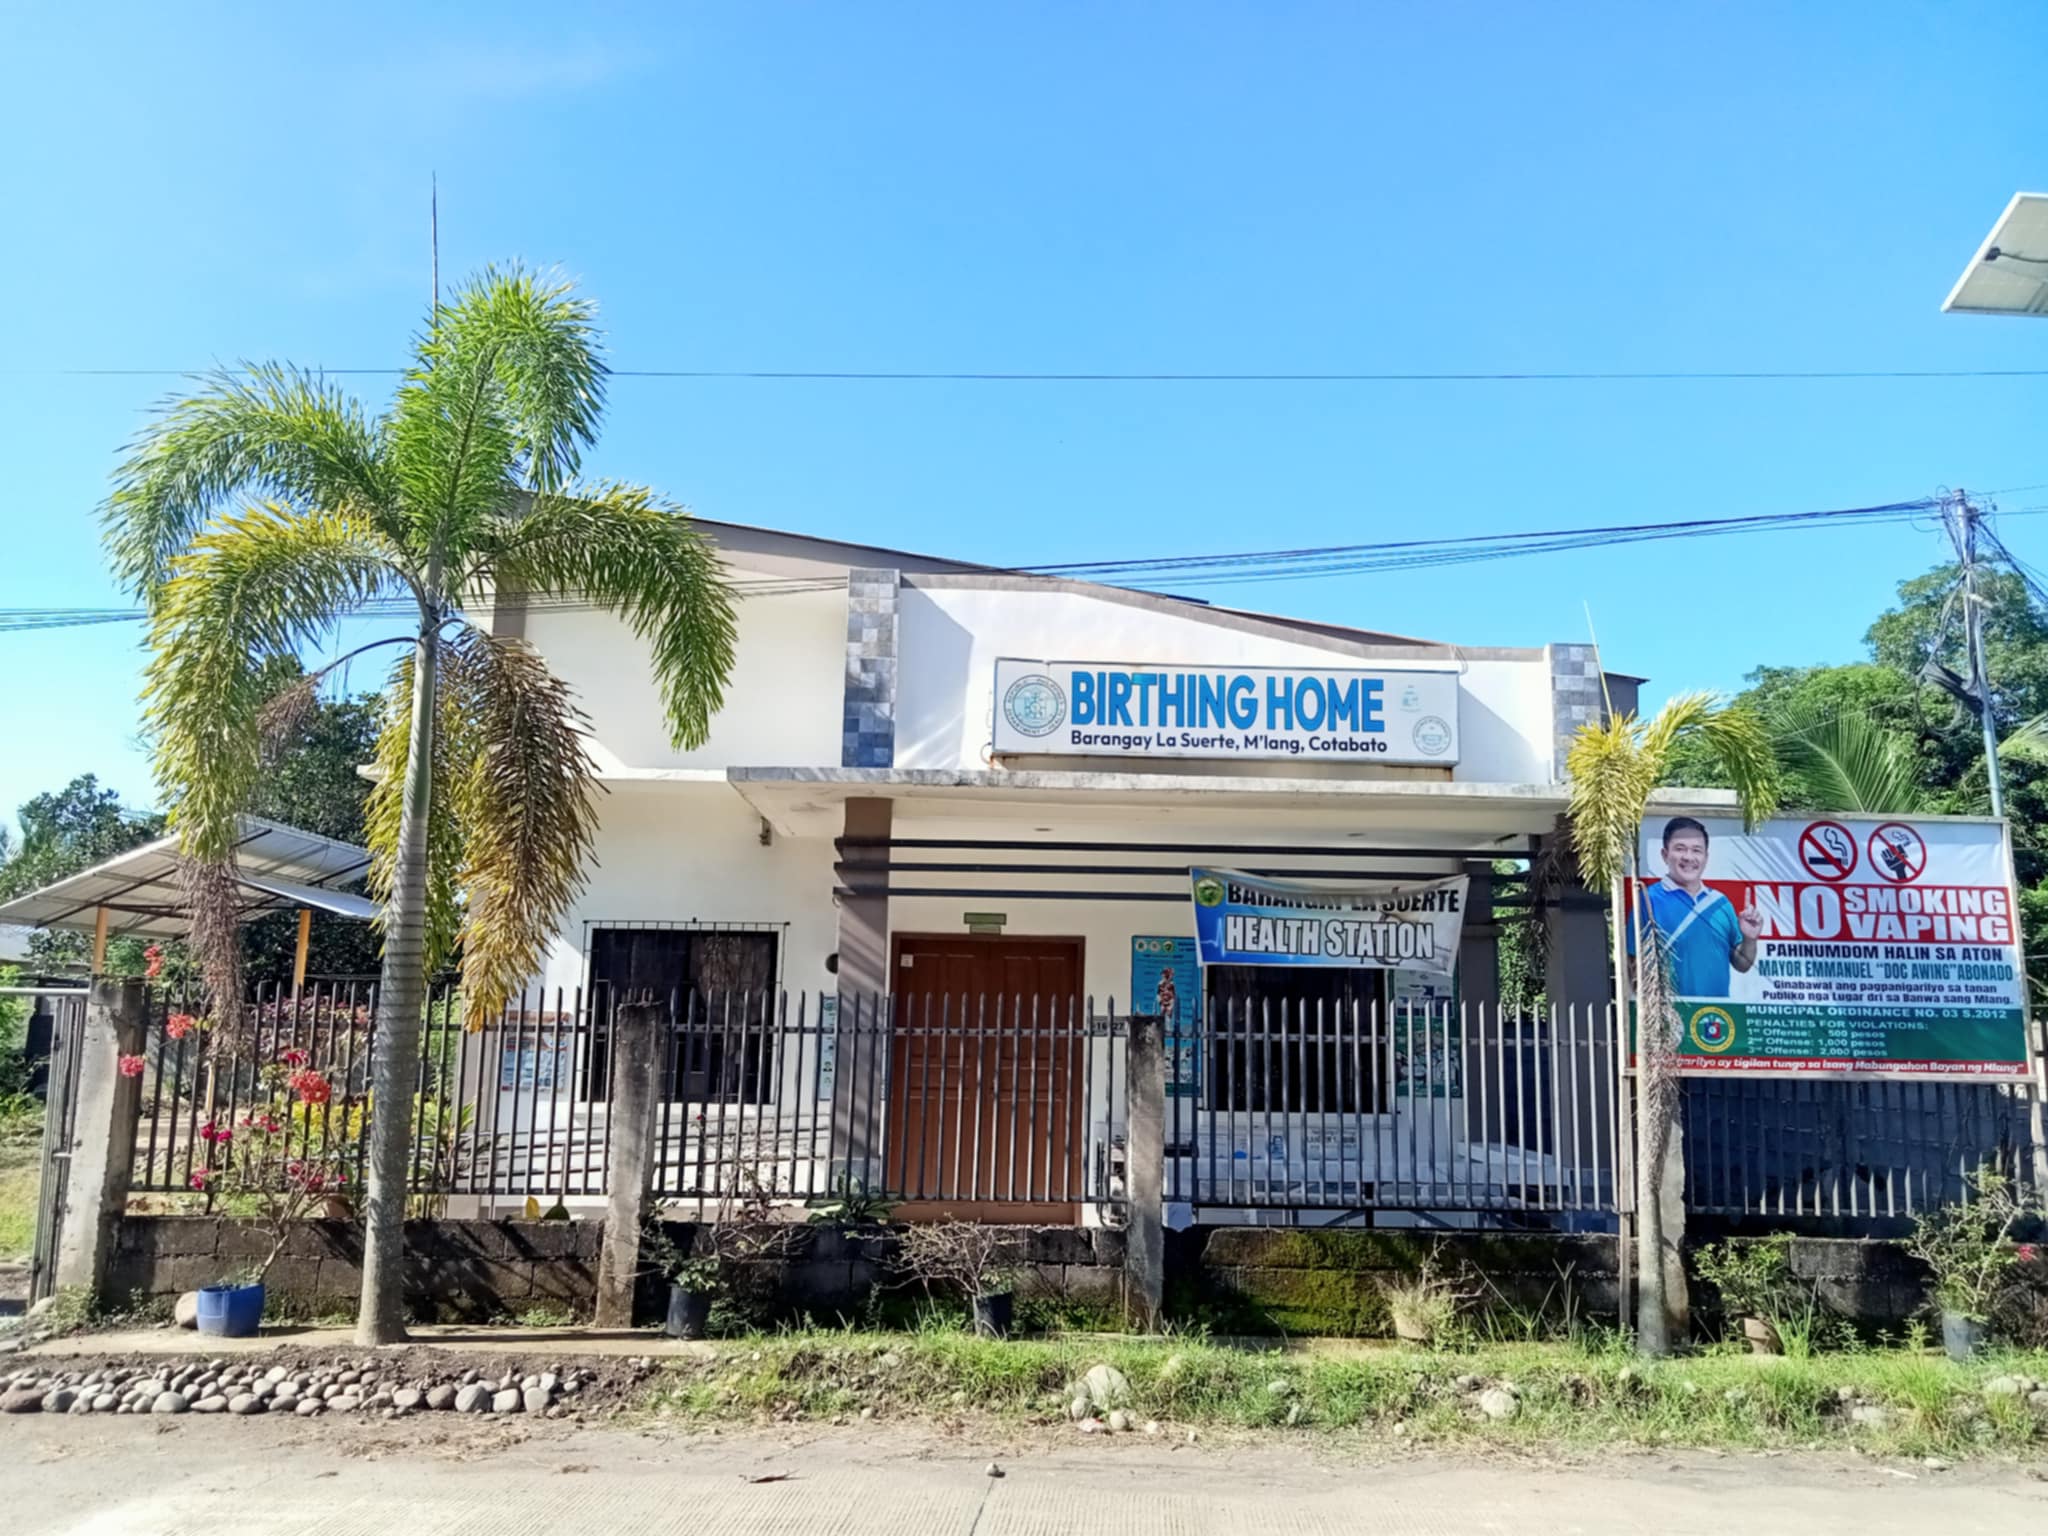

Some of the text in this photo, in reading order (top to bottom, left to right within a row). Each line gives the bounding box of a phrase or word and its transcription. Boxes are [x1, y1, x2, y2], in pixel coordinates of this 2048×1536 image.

[1071, 671, 1258, 730] BIRTHING
[1266, 676, 1385, 732] HOME
[1071, 730, 1387, 754] Barangay La Suerte, M'lang, Cotabato
[1755, 884, 2007, 939] NO SMOKING
[1845, 914, 2010, 942] VAPING
[1225, 914, 1435, 960] HEALTH STATION
[1766, 943, 2003, 962] PAHINUMDOM HALIN SA ATON
[1758, 959, 1802, 977] MAYOR
[1805, 961, 1873, 979] EMMANUEL
[1835, 981, 1857, 992] ang
[1948, 984, 1962, 993] sa
[1965, 983, 1997, 993] tanan
[1762, 990, 1805, 1001] Publiko
[1808, 992, 1829, 1002] nga
[1832, 991, 1863, 1003] Lugar
[1867, 991, 1883, 1001] dri
[1886, 993, 1900, 1002] sa
[1903, 993, 1940, 1003] Banwa
[1943, 994, 1971, 1005] sang
[1745, 1005, 1824, 1016] MUNICIPAL
[1827, 1006, 1911, 1017] ORDINANCE
[1915, 1008, 1939, 1018] NO.
[1942, 1008, 1958, 1018] 03
[1746, 1018, 1816, 1028] PENALTIES
[1820, 1020, 1845, 1029] FOR
[1850, 1030, 1885, 1040] pesos
[1850, 1040, 1886, 1049] pesos
[1852, 1049, 1888, 1058] pesos
[1808, 1060, 1820, 1069] sa
